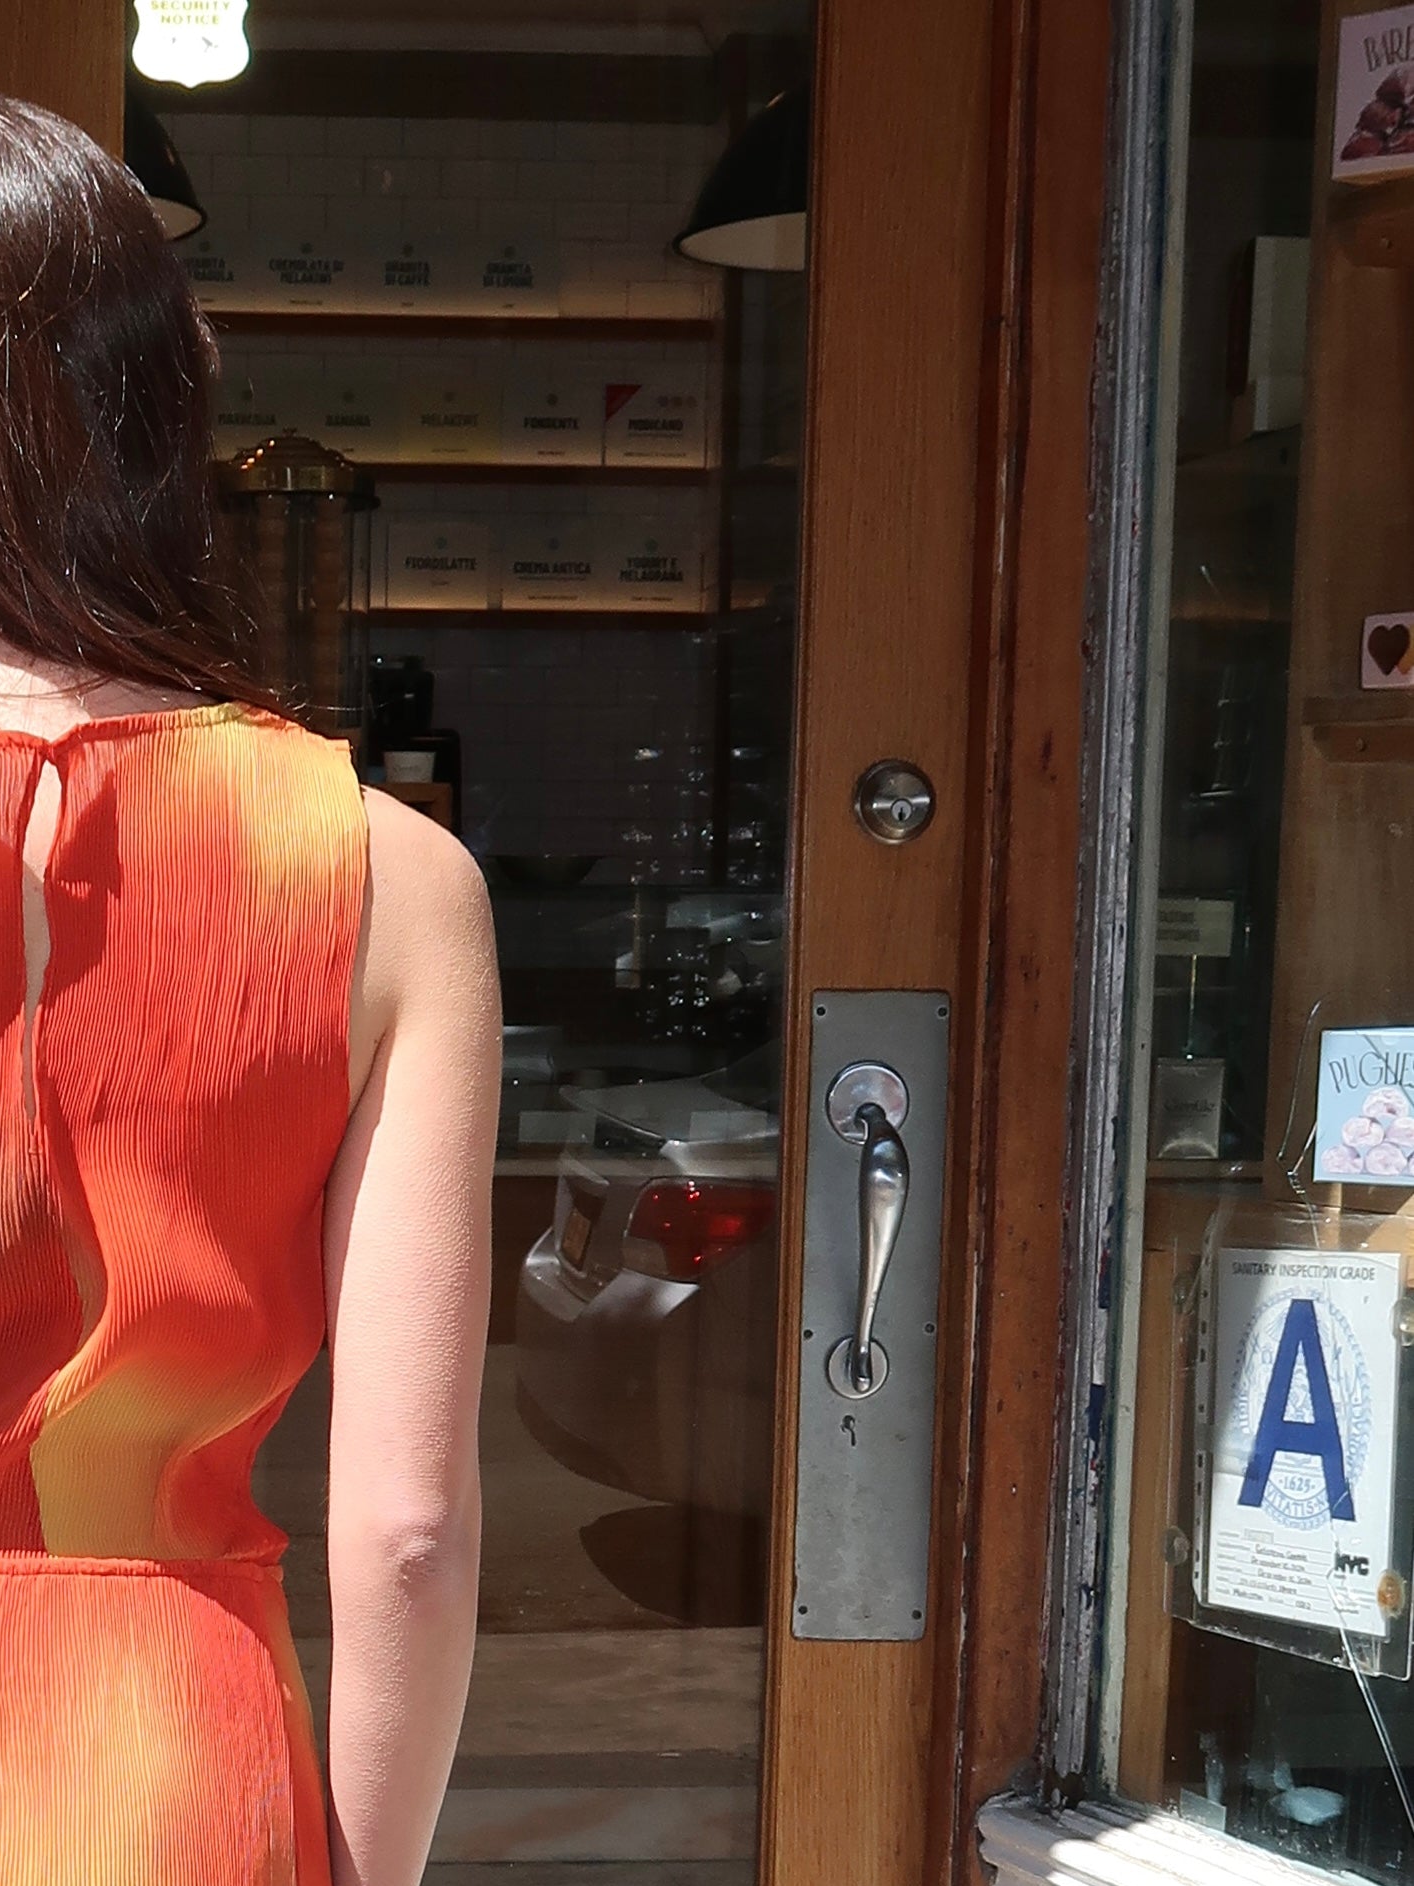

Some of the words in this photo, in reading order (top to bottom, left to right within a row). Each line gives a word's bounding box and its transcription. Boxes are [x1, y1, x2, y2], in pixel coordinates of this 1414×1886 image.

[150, 0, 230, 10] SECURITY
[161, 14, 220, 25] NOTICE
[1232, 1261, 1276, 1277] SANITARY
[1279, 1263, 1337, 1280] INSPECTION
[1339, 1265, 1376, 1281] GRADE
[1237, 1298, 1357, 1523] A
[1334, 1552, 1370, 1576] NYC
